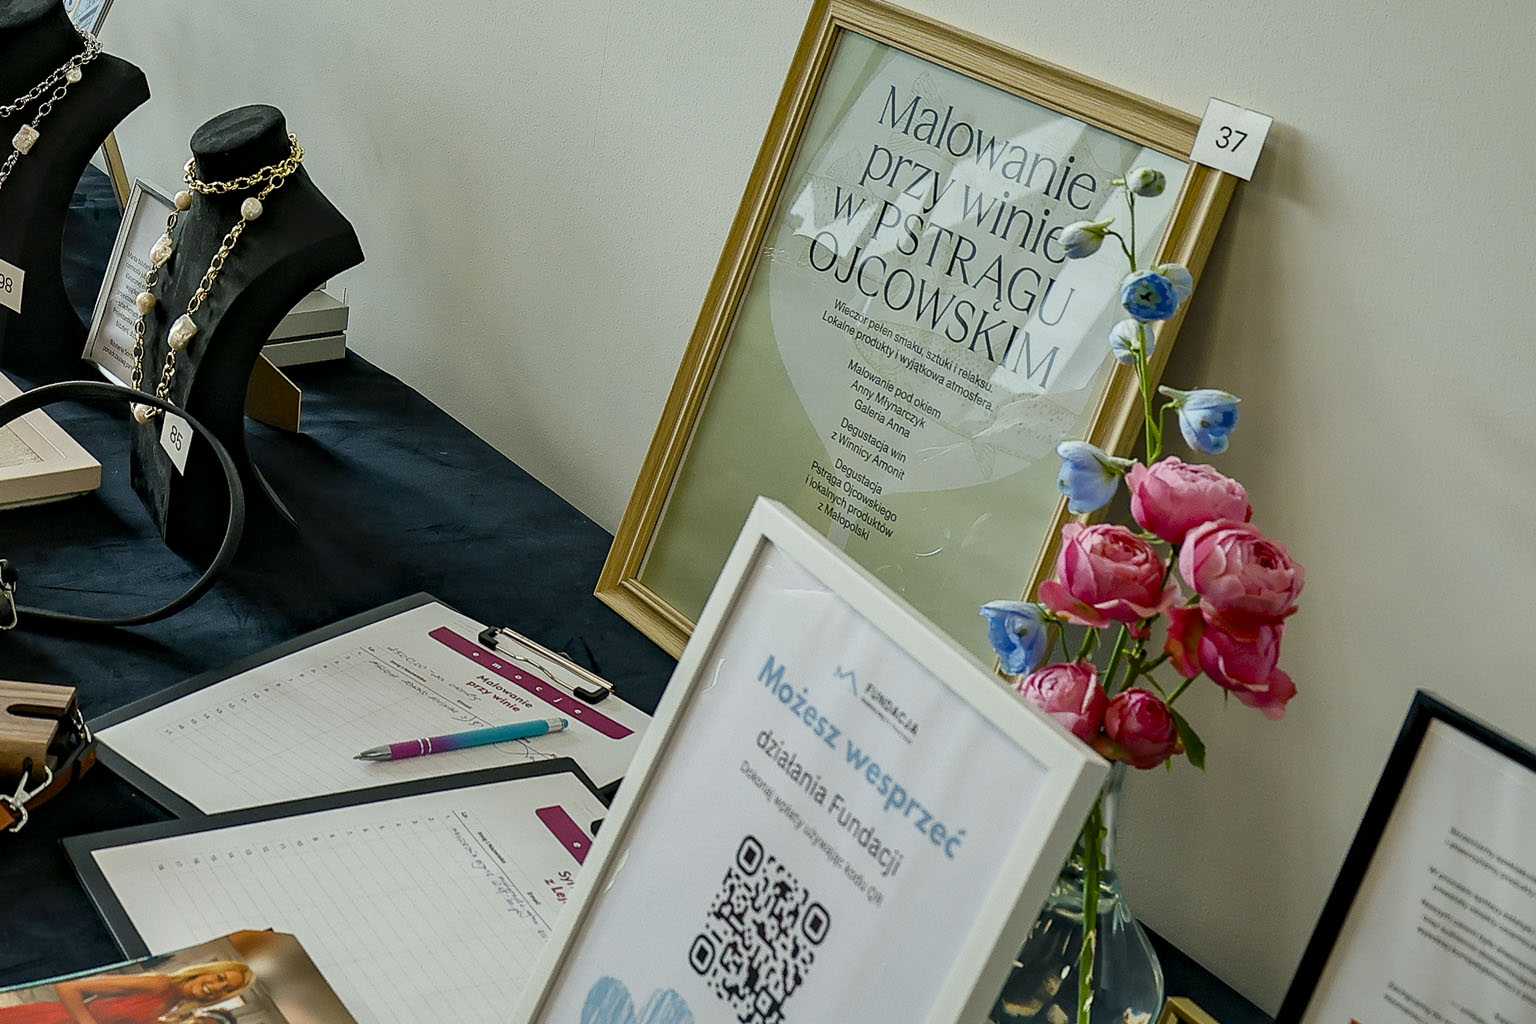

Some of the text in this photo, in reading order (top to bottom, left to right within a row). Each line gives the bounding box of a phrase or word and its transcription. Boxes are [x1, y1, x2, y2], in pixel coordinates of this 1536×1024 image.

[877, 84, 1098, 211] Malowanie
[1216, 126, 1248, 152] 37
[859, 143, 1066, 264] przy winie
[833, 185, 1076, 327] w PSTRĄGU
[808, 230, 1060, 390] OJCOWSKIM
[822, 310, 855, 337] Lokalne
[855, 331, 894, 358] produkty
[900, 354, 944, 385] wyjątkowa
[946, 380, 993, 412] atmosfera.
[867, 320, 893, 338] pełen
[894, 334, 923, 357] smaku,
[926, 351, 953, 370] sztuki
[958, 368, 992, 393] relaksu.
[848, 359, 941, 419] Malowanie pod okiem
[851, 380, 925, 428] Anny Młynarczyk
[170, 425, 183, 451] 85
[841, 417, 906, 463] Degustacja win
[855, 399, 910, 438] Galeria Anna
[831, 432, 904, 480] z Winnicy Amonit
[835, 458, 882, 495] Degustacja
[809, 477, 846, 509] lokalnych
[847, 504, 893, 537] produktów
[811, 460, 897, 522] Pstrąga Ojcowskiego
[817, 502, 870, 541] z Małopolski
[466, 680, 520, 713] przy winie
[477, 674, 533, 709] Malowanie
[865, 682, 920, 736] FUNDACJA
[757, 653, 841, 751] Możesz
[845, 734, 967, 860] wesprzeć
[756, 728, 905, 880] działania Fundacji
